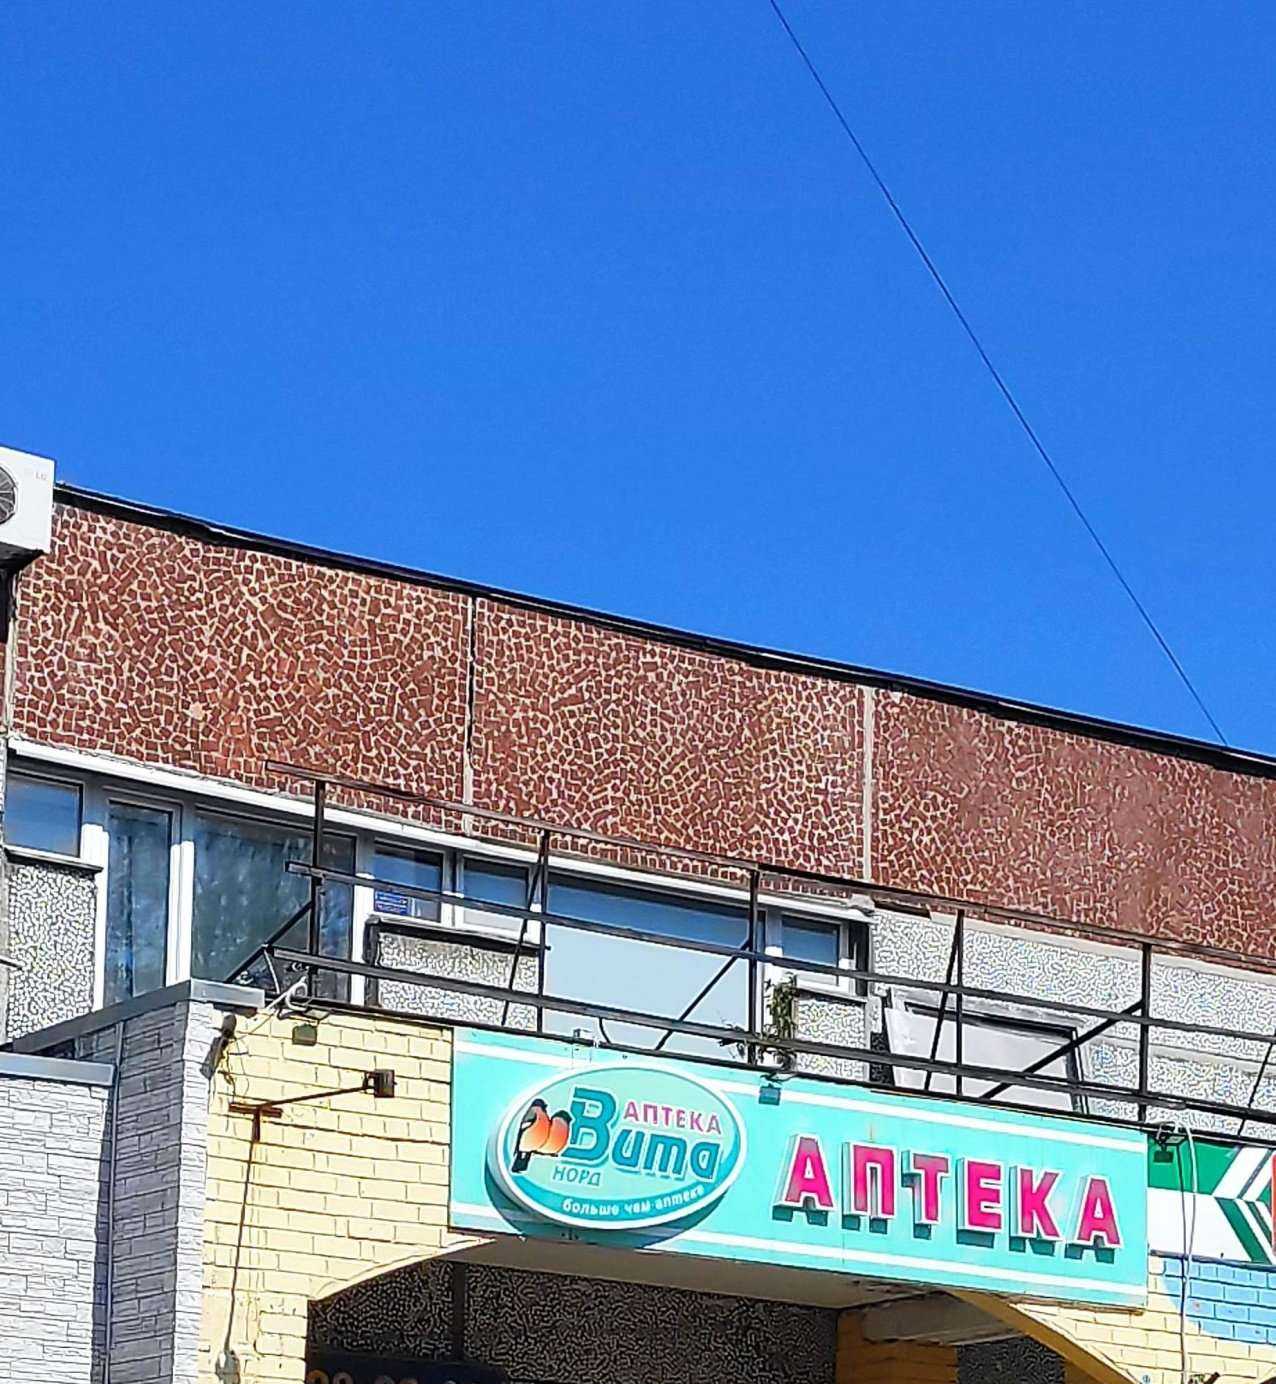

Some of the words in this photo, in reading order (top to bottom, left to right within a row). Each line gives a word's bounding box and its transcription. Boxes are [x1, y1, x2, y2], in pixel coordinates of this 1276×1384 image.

[561, 1086, 722, 1180] Вита
[623, 1101, 722, 1135] АПТЕКА
[552, 1165, 602, 1188] НОРД
[774, 1134, 1123, 1250] АПТЕКА
[562, 1198, 620, 1216] больше
